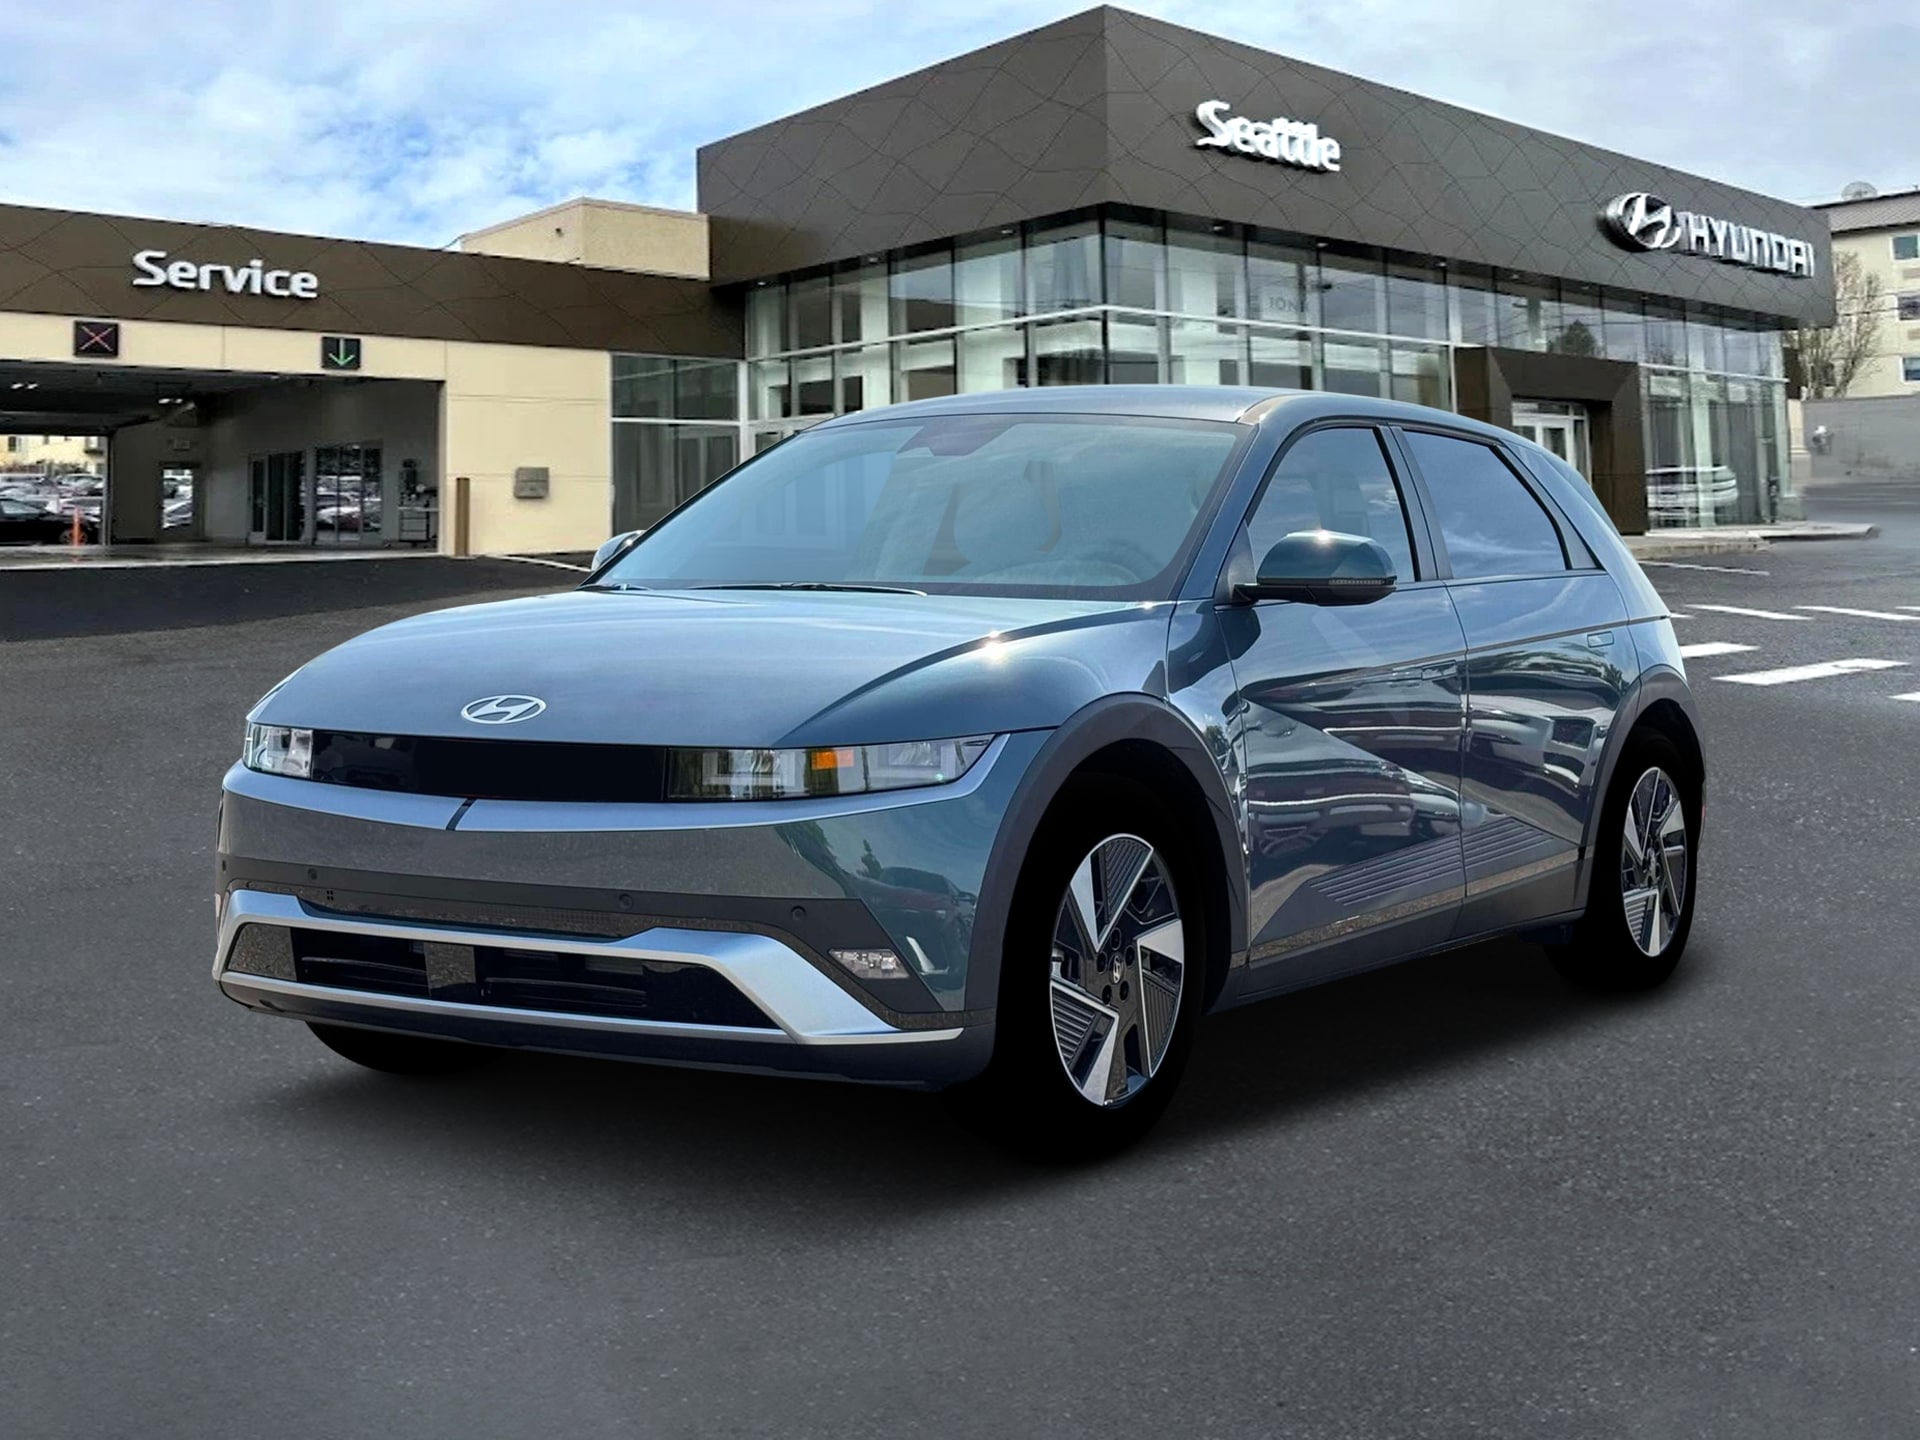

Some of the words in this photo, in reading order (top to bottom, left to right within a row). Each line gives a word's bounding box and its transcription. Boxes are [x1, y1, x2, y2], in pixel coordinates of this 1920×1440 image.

[1196, 99, 1341, 172] Seattle
[132, 249, 319, 299] Service
[1677, 211, 1815, 278] HYUNDAI
